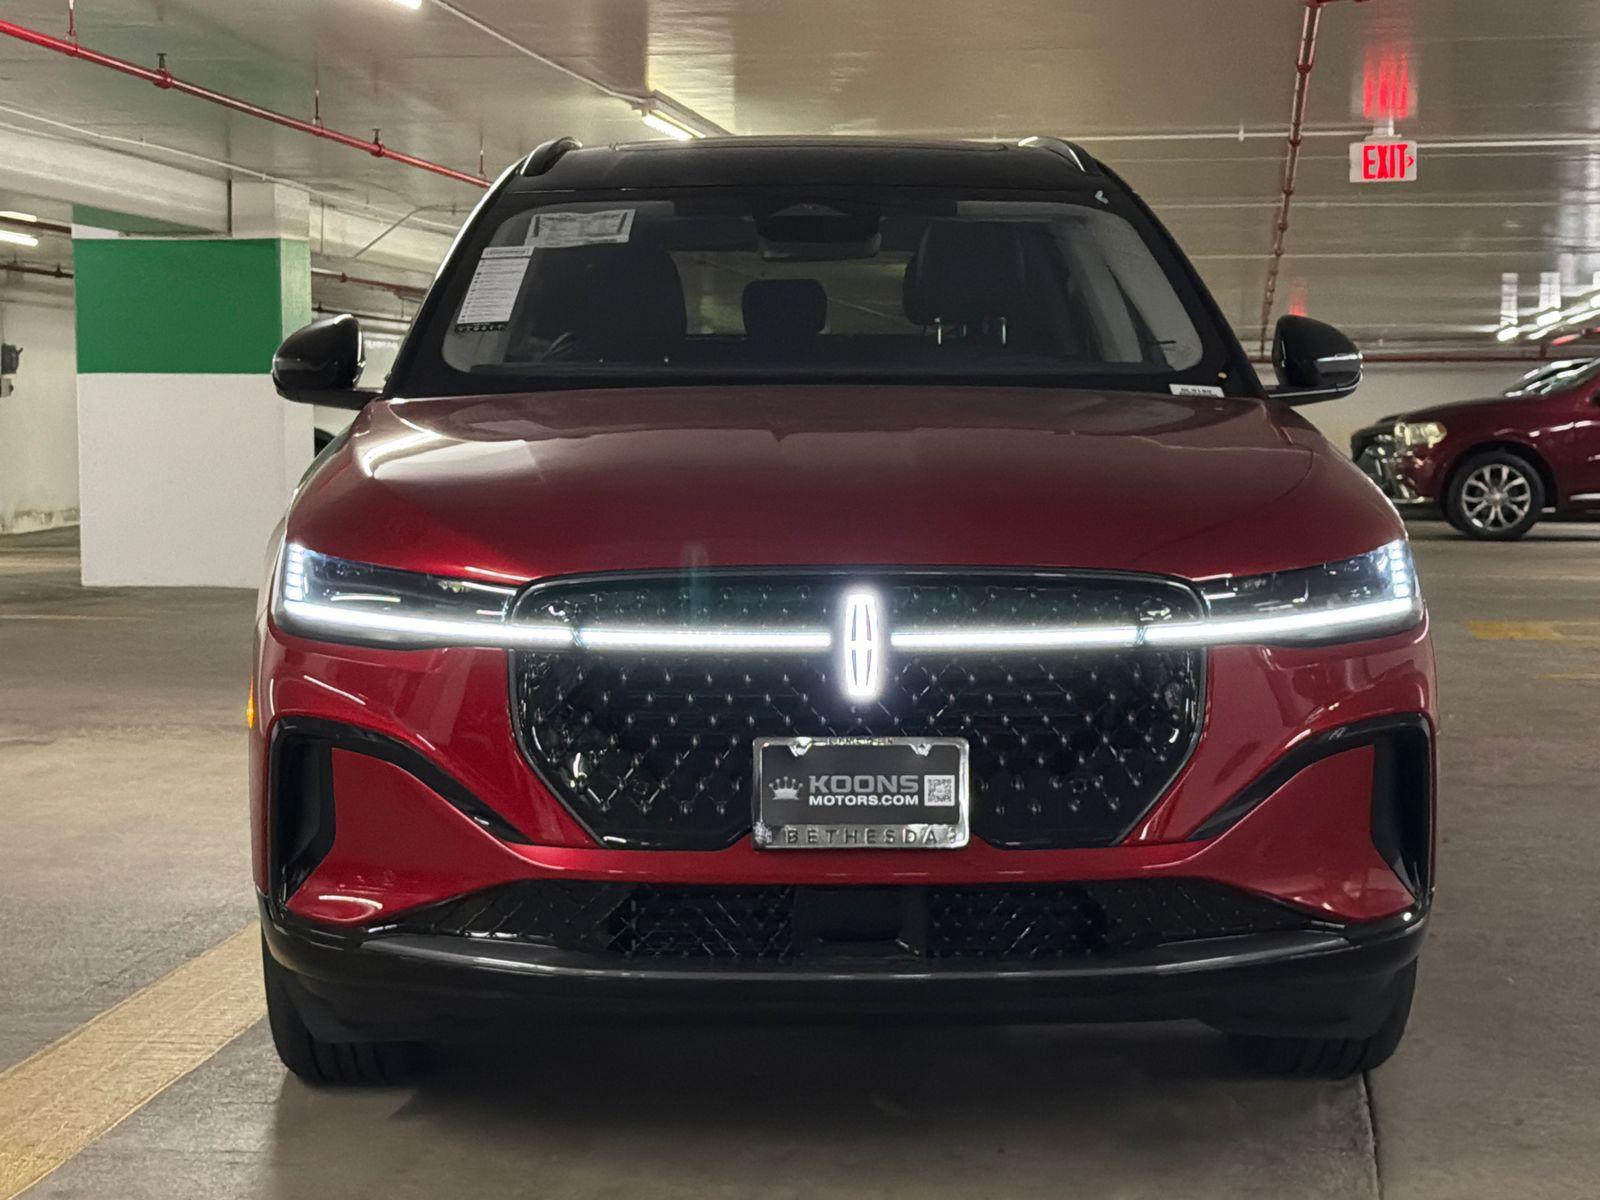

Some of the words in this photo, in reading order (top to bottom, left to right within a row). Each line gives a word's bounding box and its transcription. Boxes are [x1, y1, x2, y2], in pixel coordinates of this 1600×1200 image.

[1363, 144, 1408, 179] EXIT
[808, 775, 919, 793] KOONS
[808, 795, 919, 806] MOTORS.COM
[786, 827, 939, 844] BETHESDA
